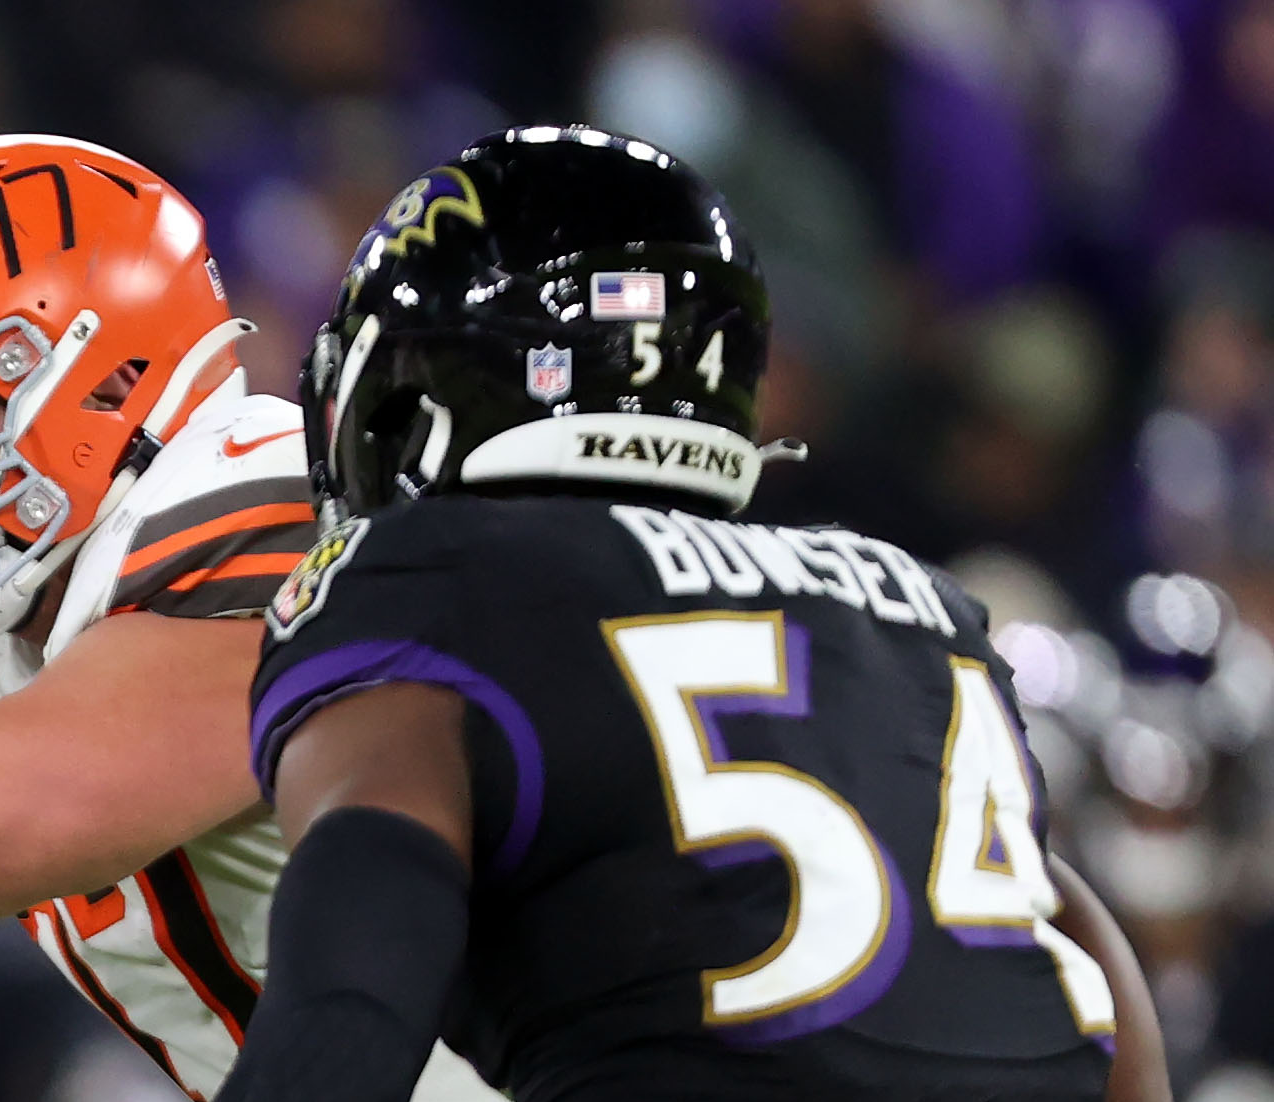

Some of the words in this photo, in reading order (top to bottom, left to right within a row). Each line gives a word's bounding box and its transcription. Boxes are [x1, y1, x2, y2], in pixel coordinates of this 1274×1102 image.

[576, 432, 745, 480] RAVENS
[609, 504, 957, 638] BOWSER
[598, 608, 1117, 1050] 54
